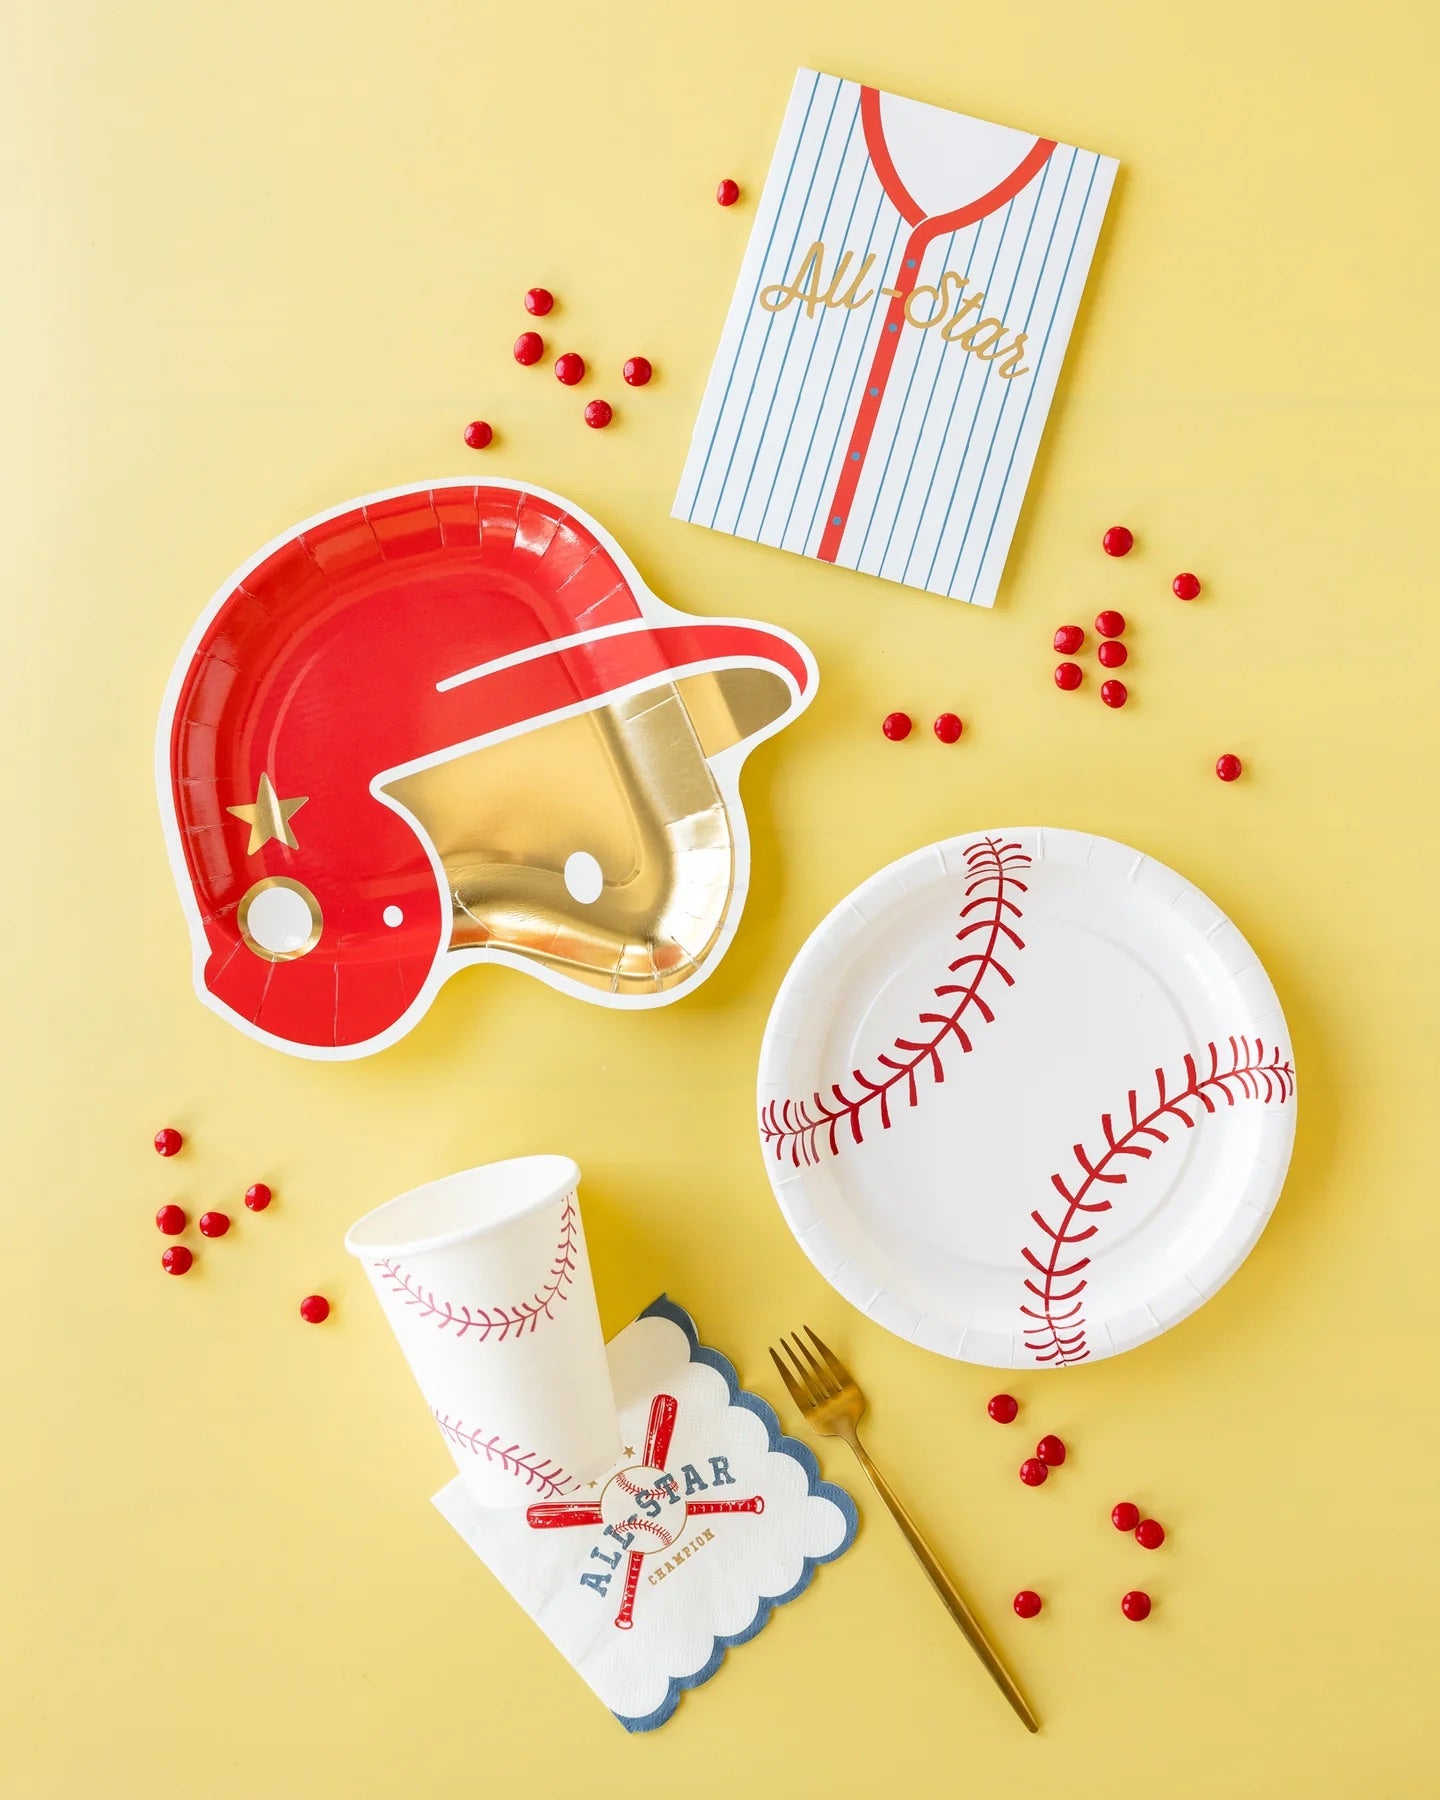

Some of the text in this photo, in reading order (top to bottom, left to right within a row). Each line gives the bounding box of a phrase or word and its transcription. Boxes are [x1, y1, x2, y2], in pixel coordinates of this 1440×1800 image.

[760, 241, 1029, 379] All-Star
[580, 1456, 736, 1598] ALL-STAR
[648, 1528, 715, 1586] CHAMPION
